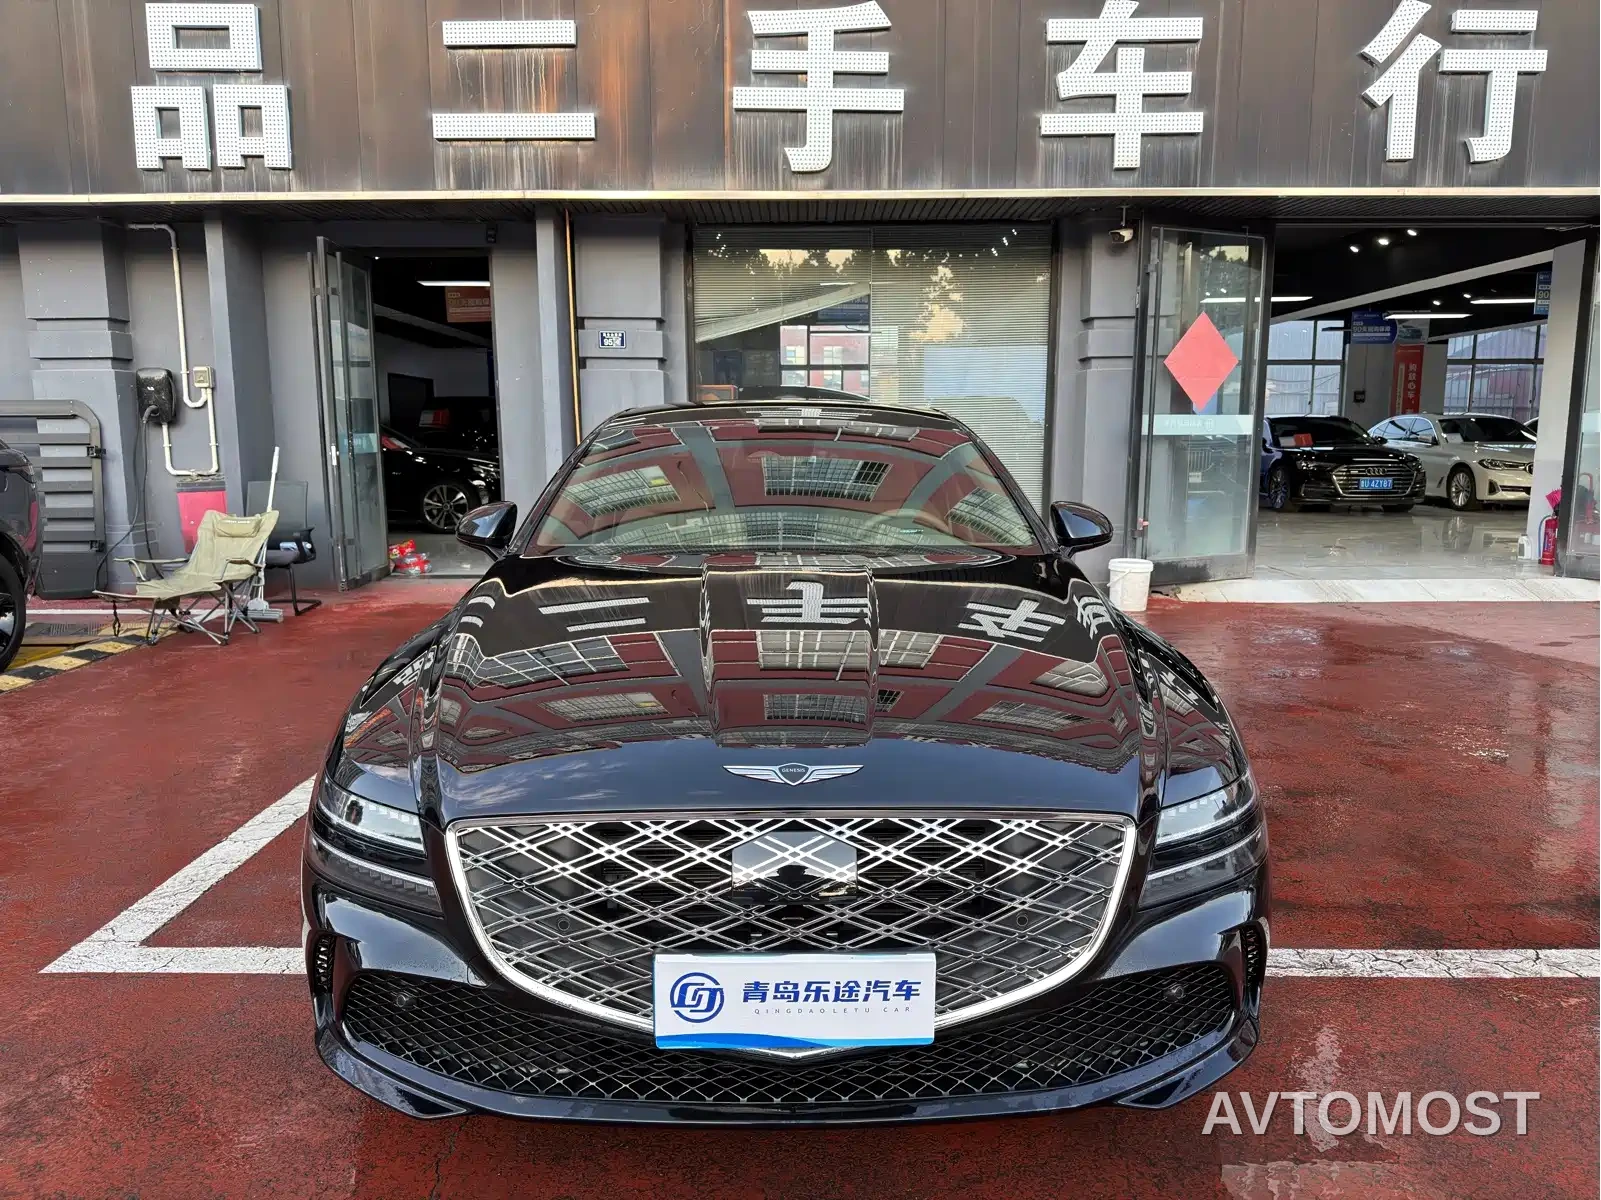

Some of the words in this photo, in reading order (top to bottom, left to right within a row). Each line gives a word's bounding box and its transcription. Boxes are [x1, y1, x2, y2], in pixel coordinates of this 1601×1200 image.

[131, 0, 1548, 171] 品二手车行
[742, 979, 922, 1004] 青岛乐途汽车
